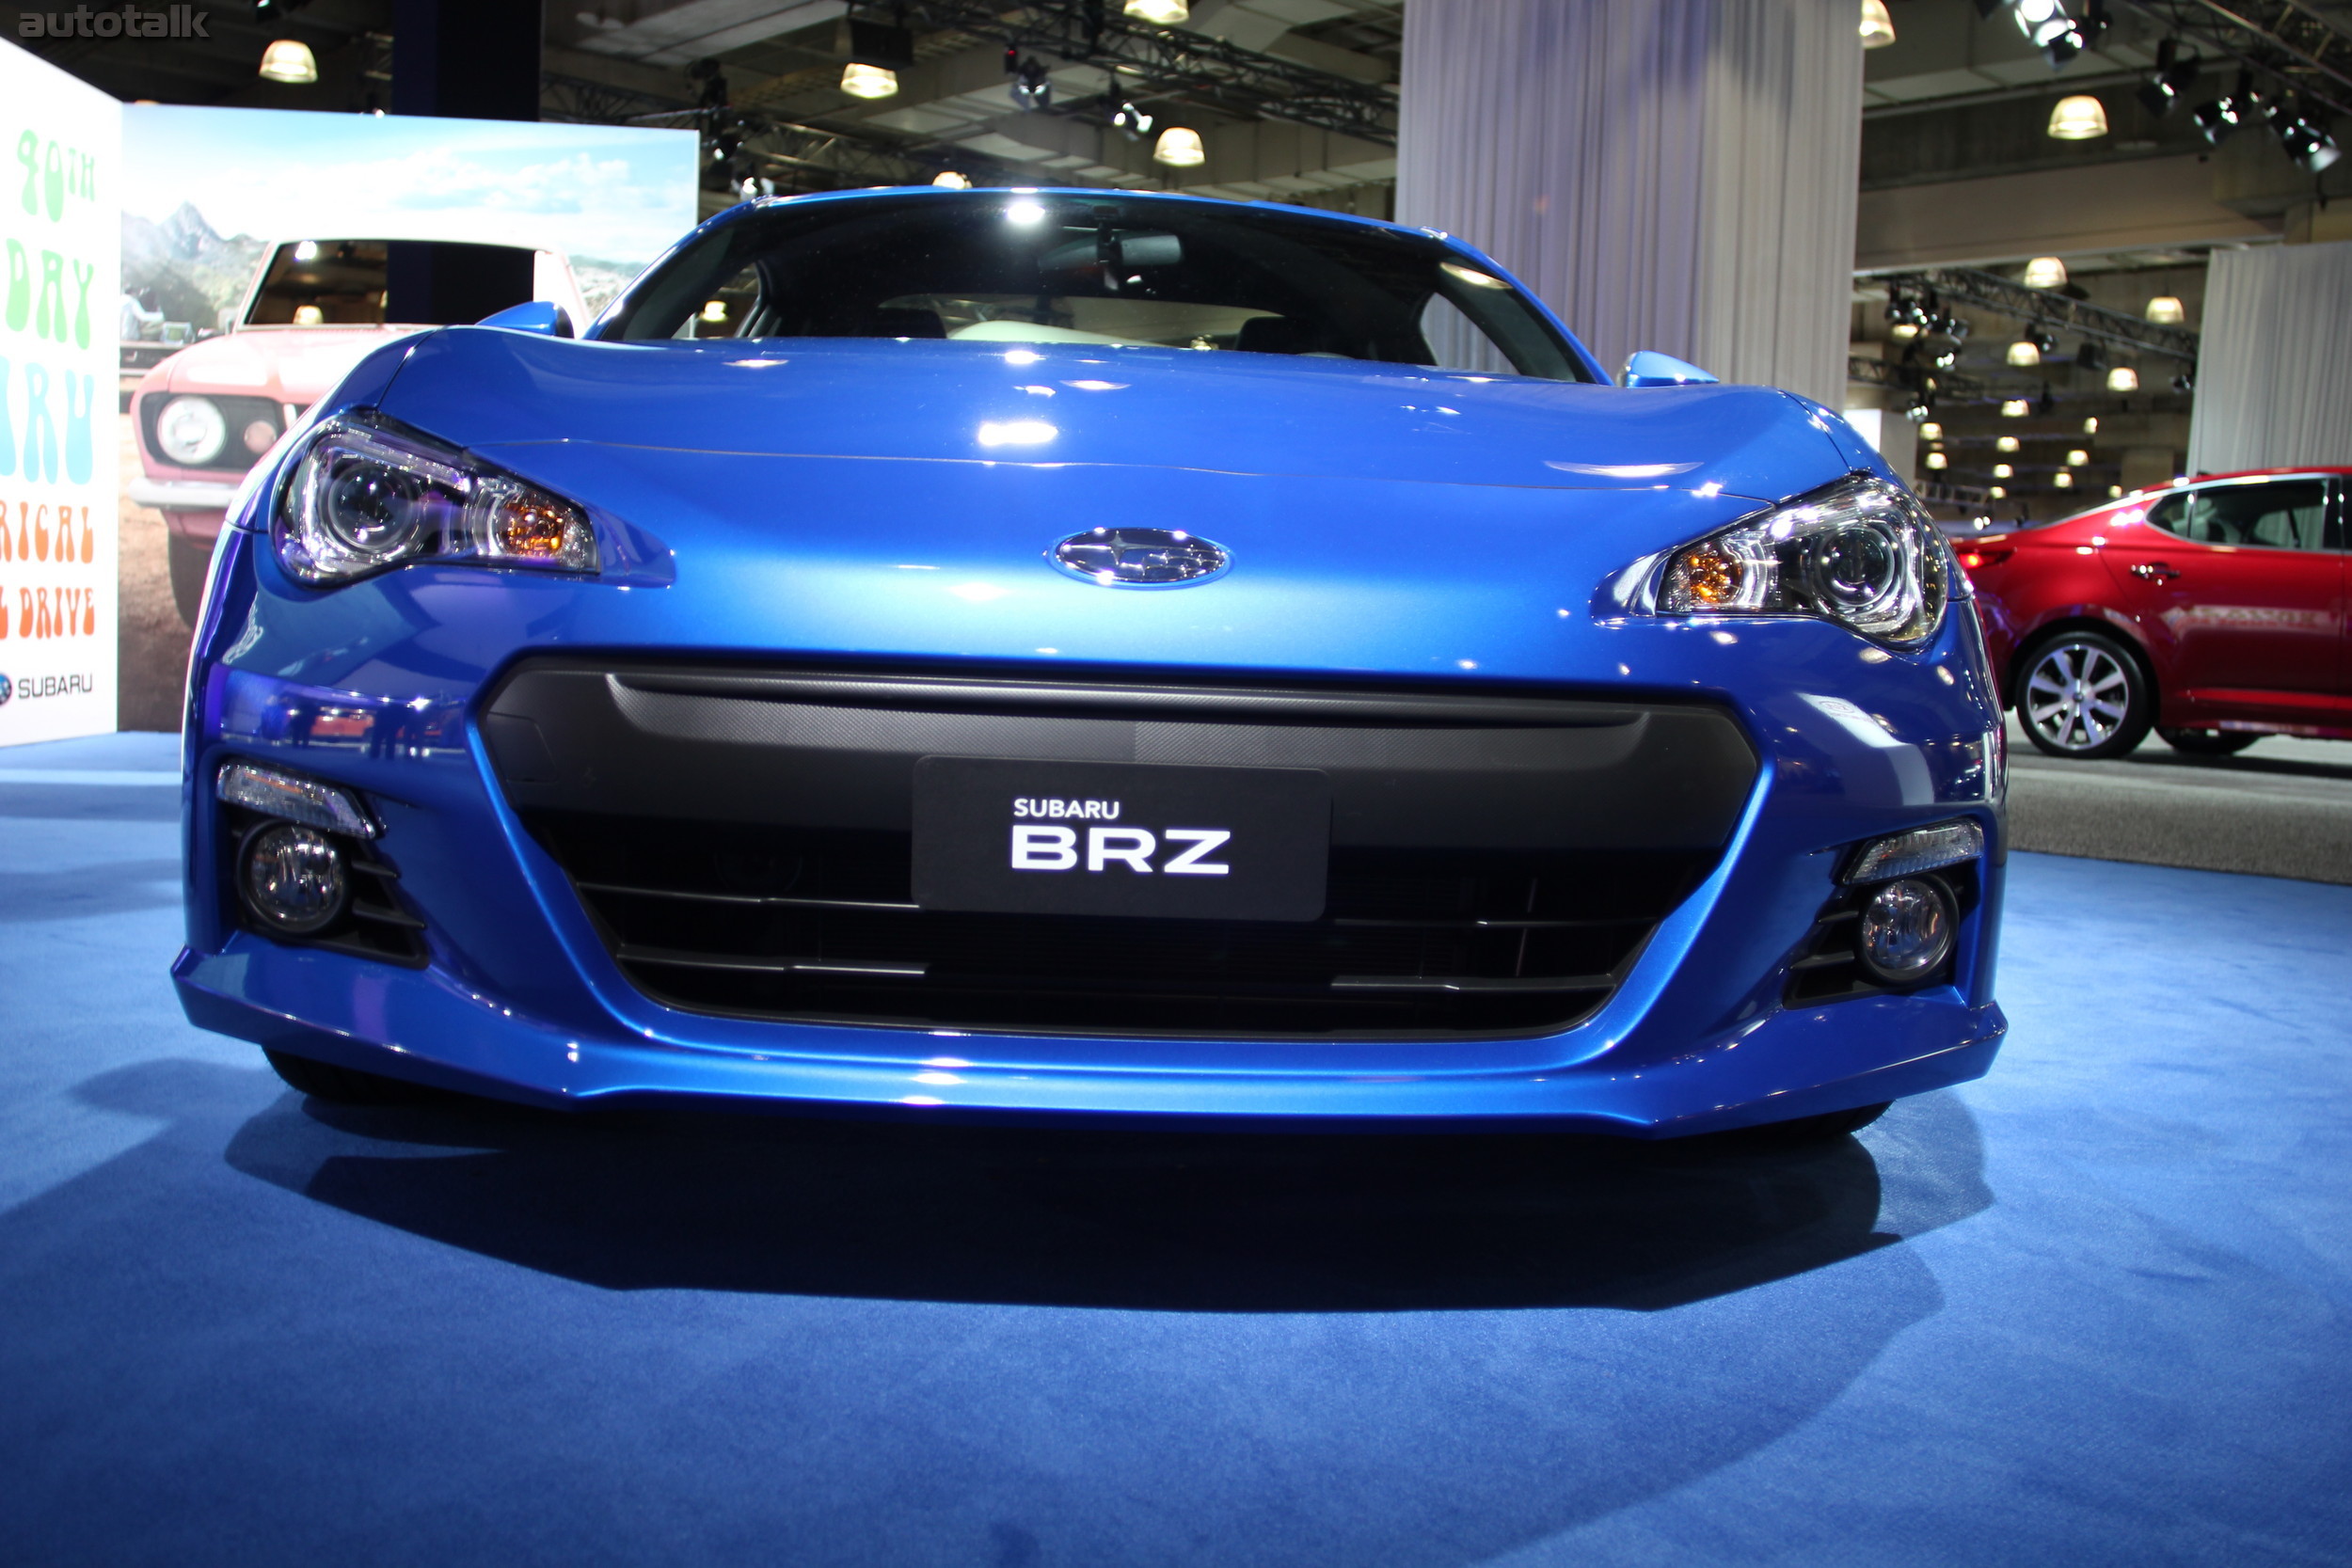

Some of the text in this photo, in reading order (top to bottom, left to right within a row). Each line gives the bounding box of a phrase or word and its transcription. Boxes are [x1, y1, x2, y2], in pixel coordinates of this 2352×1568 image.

[5, 237, 94, 350] DAY
[19, 585, 95, 640] DRIVE
[18, 673, 93, 700] SUBARU
[1013, 798, 1120, 819] SUBARU
[1011, 824, 1232, 875] BRZ
